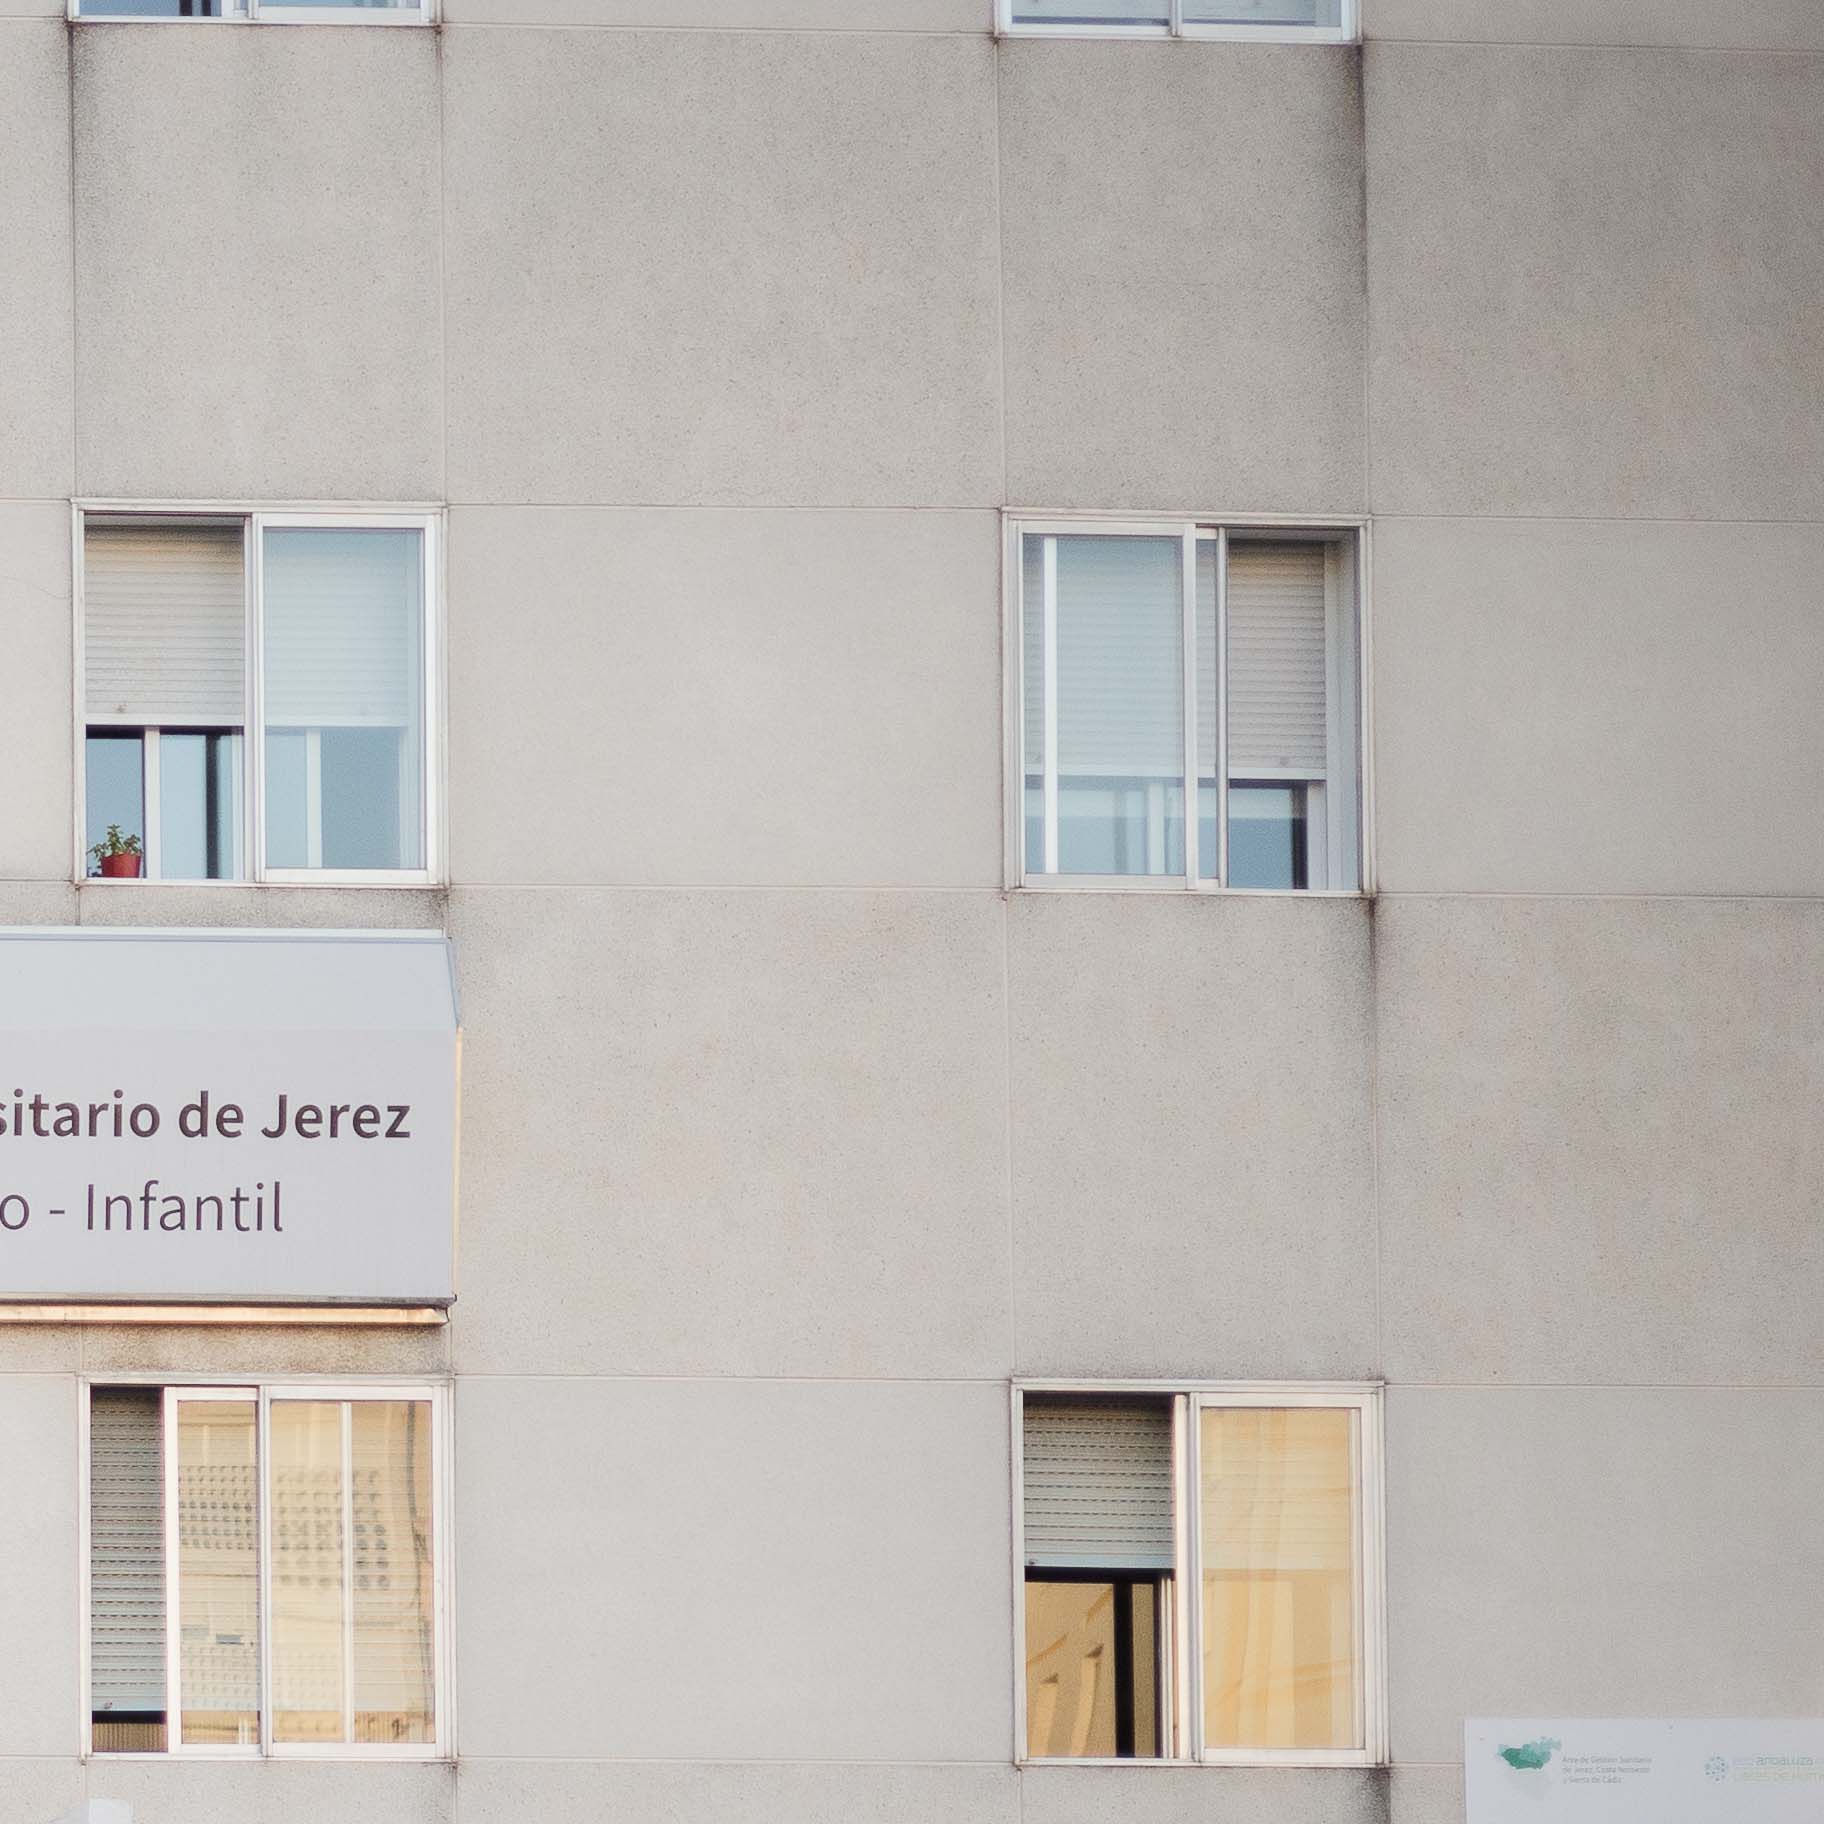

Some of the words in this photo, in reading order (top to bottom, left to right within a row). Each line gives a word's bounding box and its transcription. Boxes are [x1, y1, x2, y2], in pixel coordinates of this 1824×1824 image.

[179, 1090, 244, 1138] de
[261, 1094, 411, 1138] Jerez
[87, 1179, 283, 1232] Infantil
